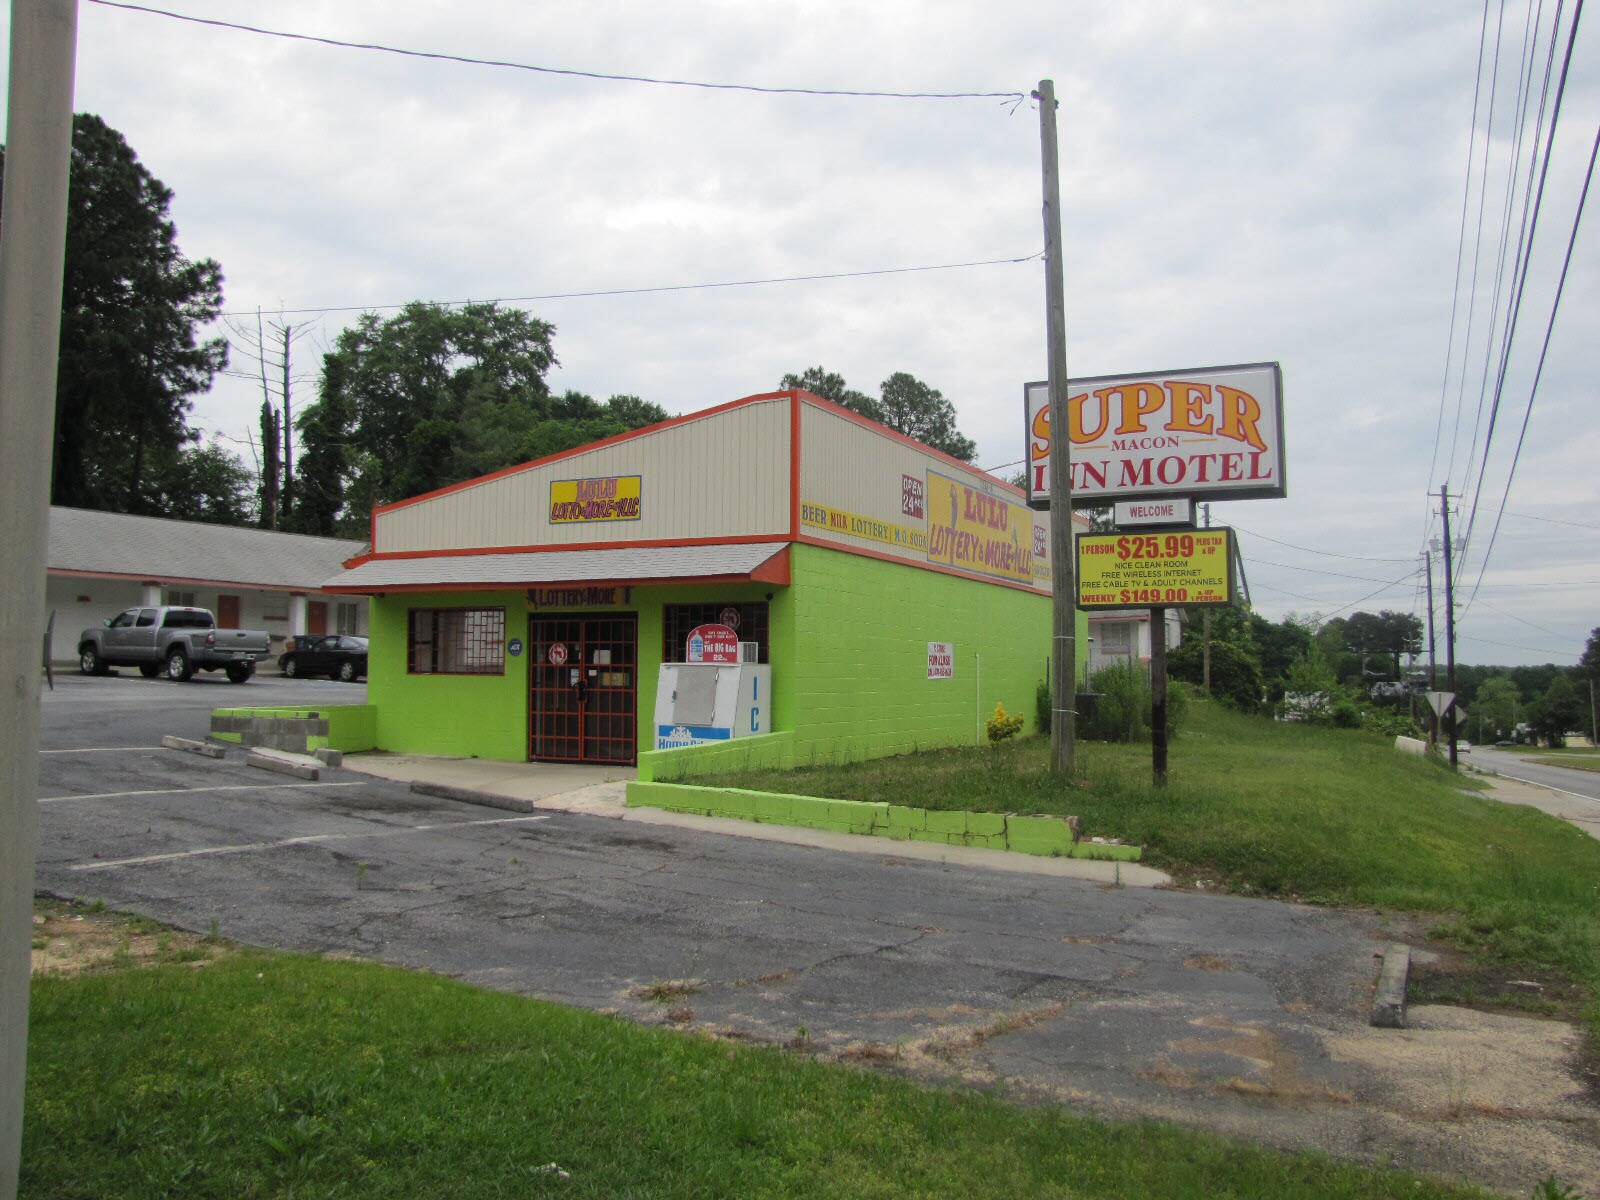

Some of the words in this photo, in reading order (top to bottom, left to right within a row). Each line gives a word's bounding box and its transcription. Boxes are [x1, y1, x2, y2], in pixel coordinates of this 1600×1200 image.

[1110, 436, 1179, 451] MACON
[1120, 452, 1272, 486] MOTEL
[576, 479, 618, 501] LULU
[903, 478, 922, 496] OPEN
[552, 502, 581, 520] LOTTO
[903, 494, 914, 512] 24
[964, 488, 1008, 531] LULU
[1130, 505, 1173, 517] WELCOME
[802, 504, 826, 525] BEER
[852, 518, 888, 539] LOTTERY
[910, 532, 926, 548] SODA
[929, 523, 979, 564] LOTTERY
[1080, 546, 1085, 555] 1
[1086, 545, 1114, 555] PERSON
[1117, 535, 1193, 560] $25.99
[1179, 578, 1223, 586] CHANNELS
[538, 589, 584, 606] LOTTERY
[588, 587, 616, 604] MORE
[1082, 594, 1116, 602] WEEKLY
[1120, 589, 1187, 603] $149.00
[704, 644, 713, 652] THE
[715, 643, 724, 652] BIG
[726, 644, 736, 652] BAG
